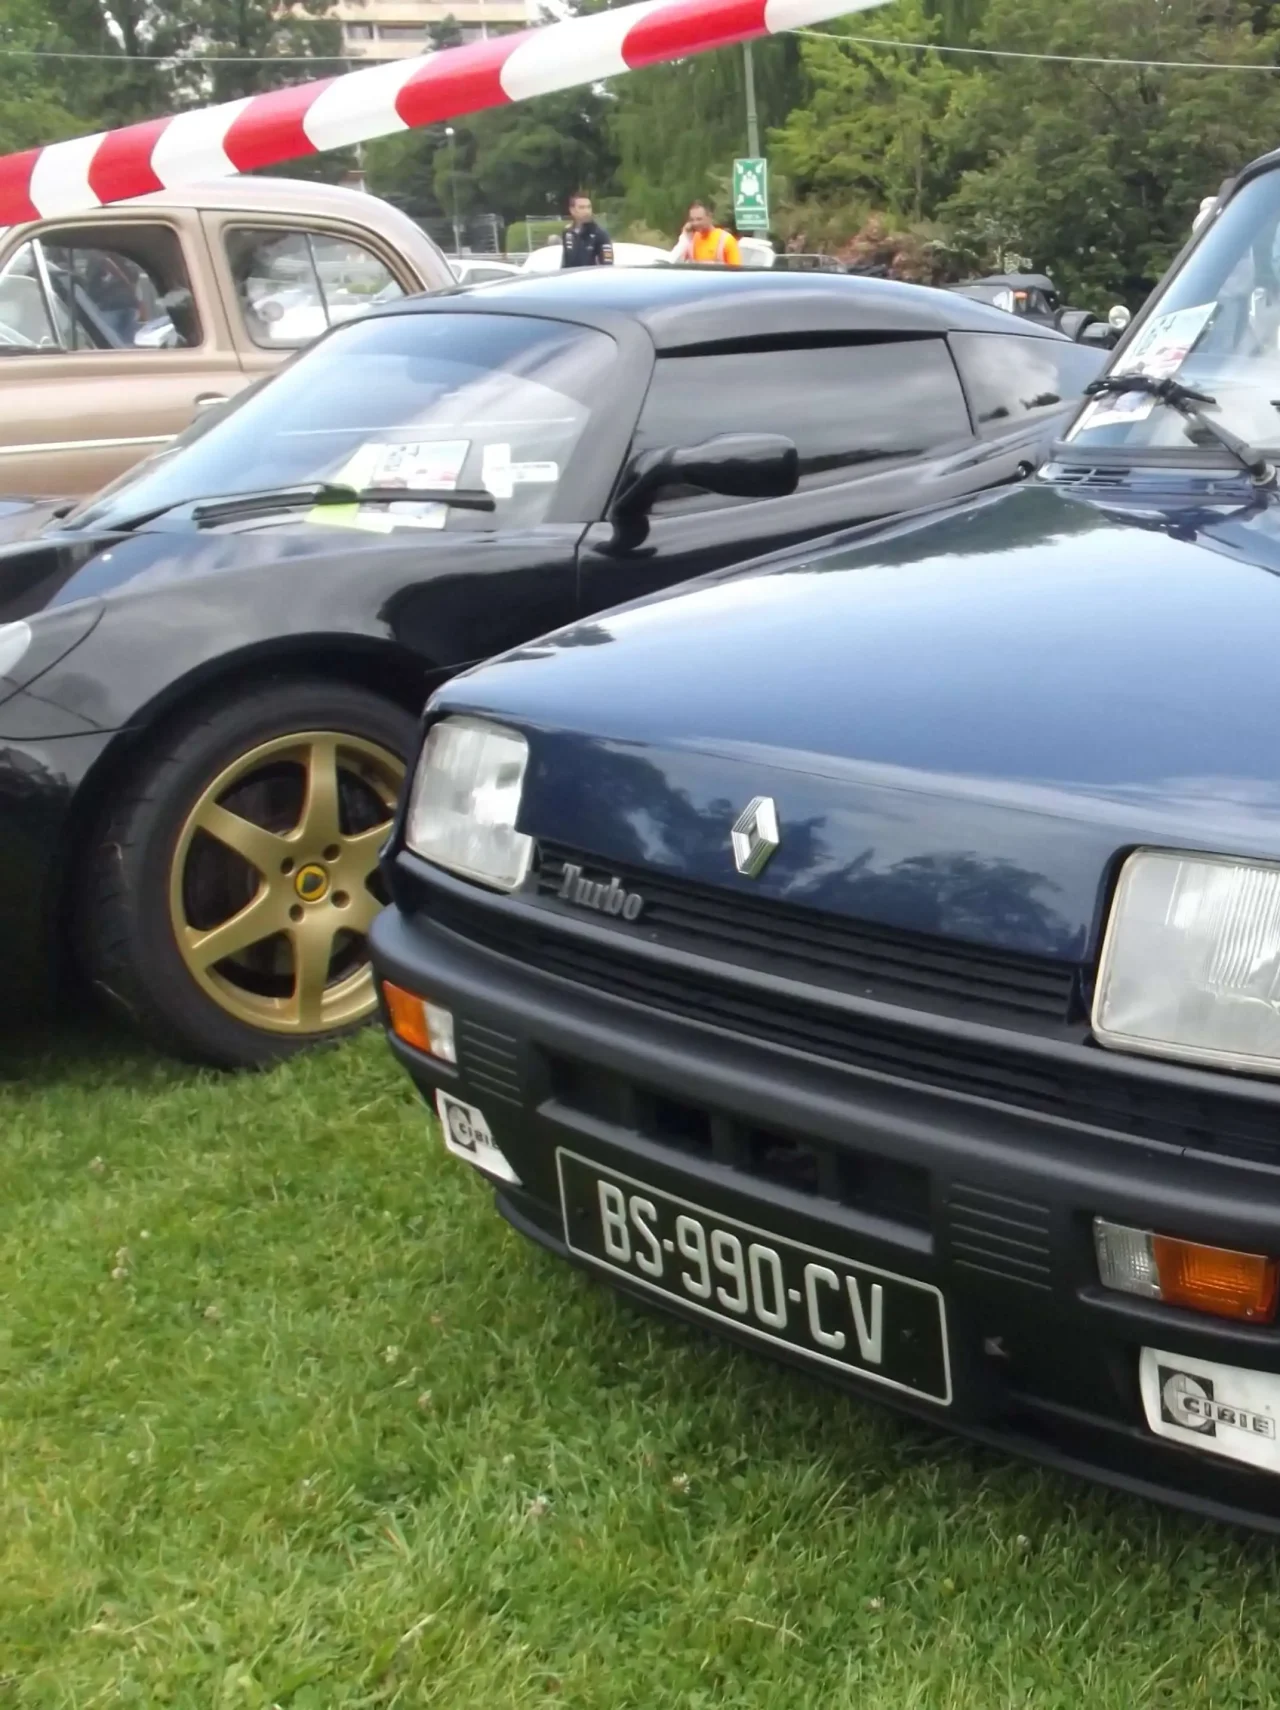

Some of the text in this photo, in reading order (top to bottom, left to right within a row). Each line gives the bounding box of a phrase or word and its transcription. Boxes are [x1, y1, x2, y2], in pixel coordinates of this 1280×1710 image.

[558, 862, 643, 920] Turbo
[597, 1179, 883, 1364] BS-990-CV
[1182, 1396, 1269, 1434] CIBIE
